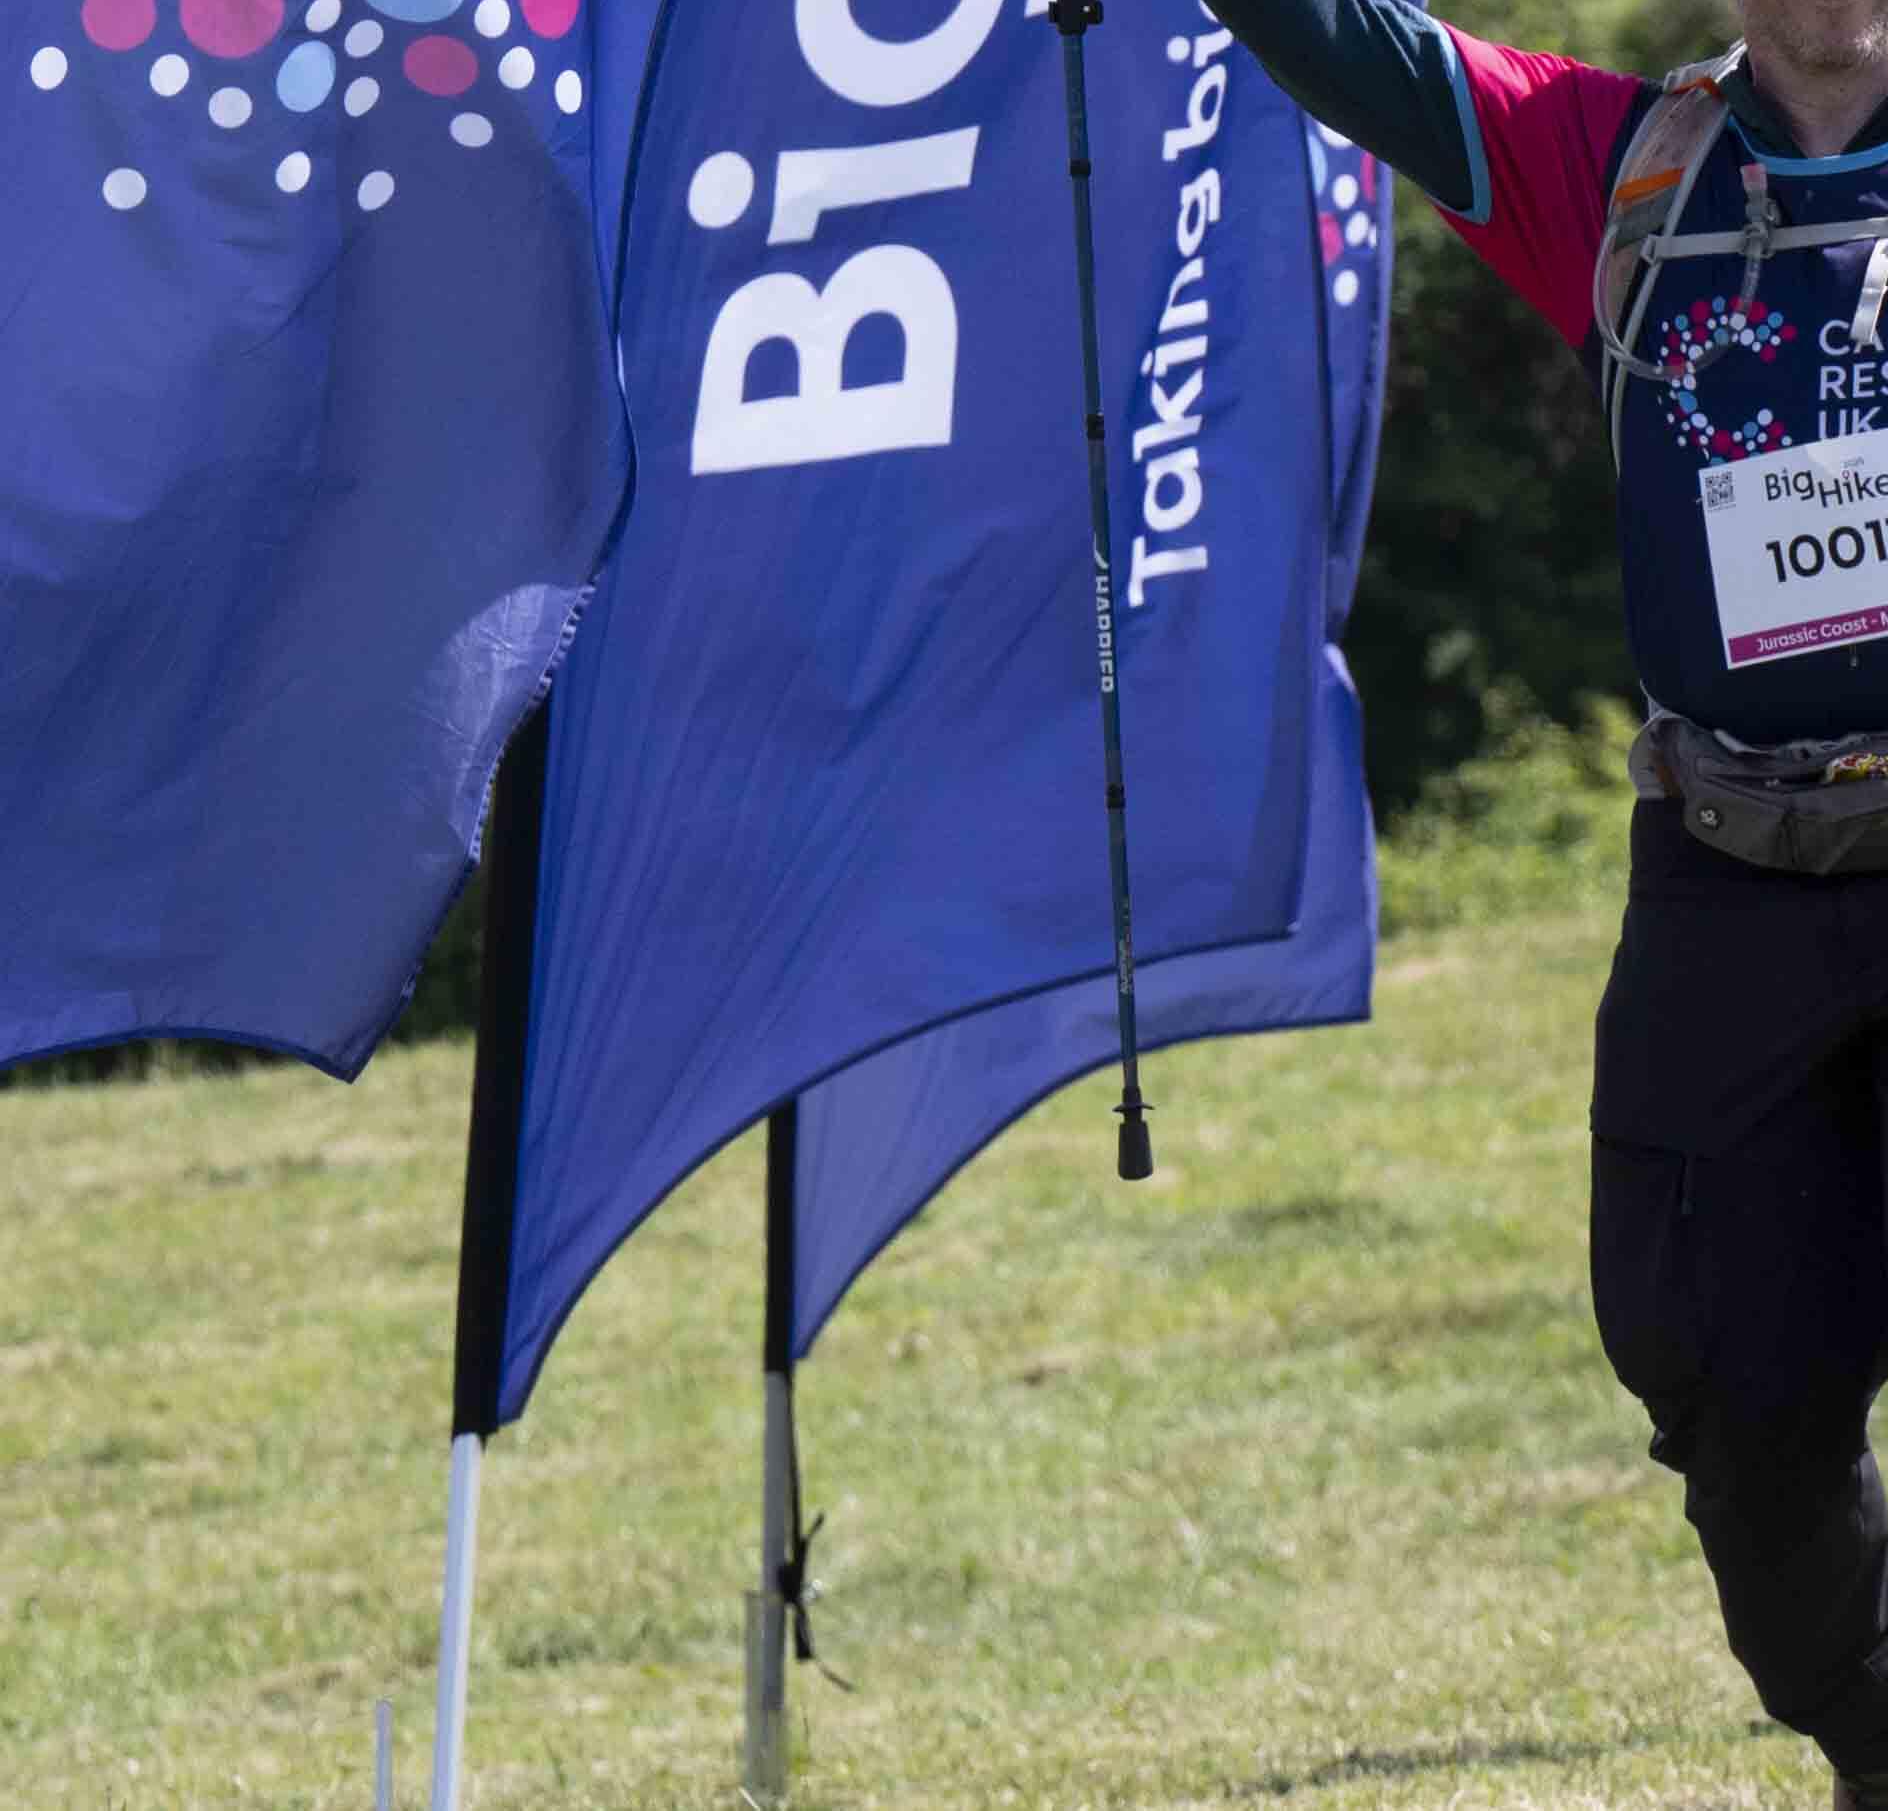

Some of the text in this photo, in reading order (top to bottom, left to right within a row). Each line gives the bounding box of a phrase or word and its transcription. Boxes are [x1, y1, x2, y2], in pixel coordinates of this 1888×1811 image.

[1128, 168, 1221, 607] Taking
[1764, 467, 1815, 502] Big
[1757, 626, 1819, 653] Jurassic
[1820, 617, 1869, 638] Coast
